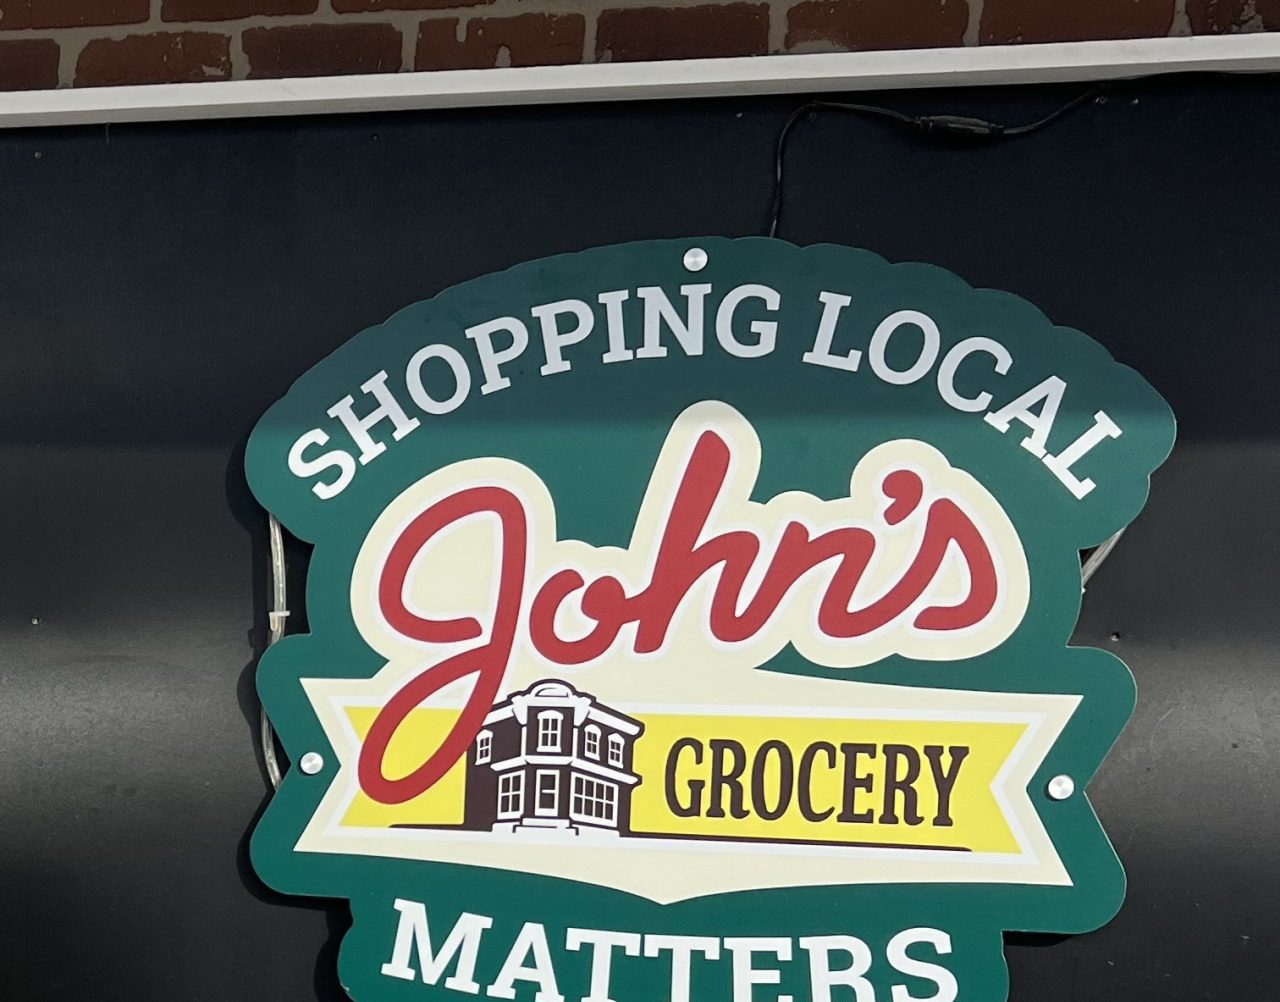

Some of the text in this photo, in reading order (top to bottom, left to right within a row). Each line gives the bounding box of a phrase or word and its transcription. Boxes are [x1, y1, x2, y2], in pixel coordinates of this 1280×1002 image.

[287, 282, 1124, 501] SHOPPING LOCAL
[357, 428, 999, 805] John's
[663, 735, 971, 828] GROCERY
